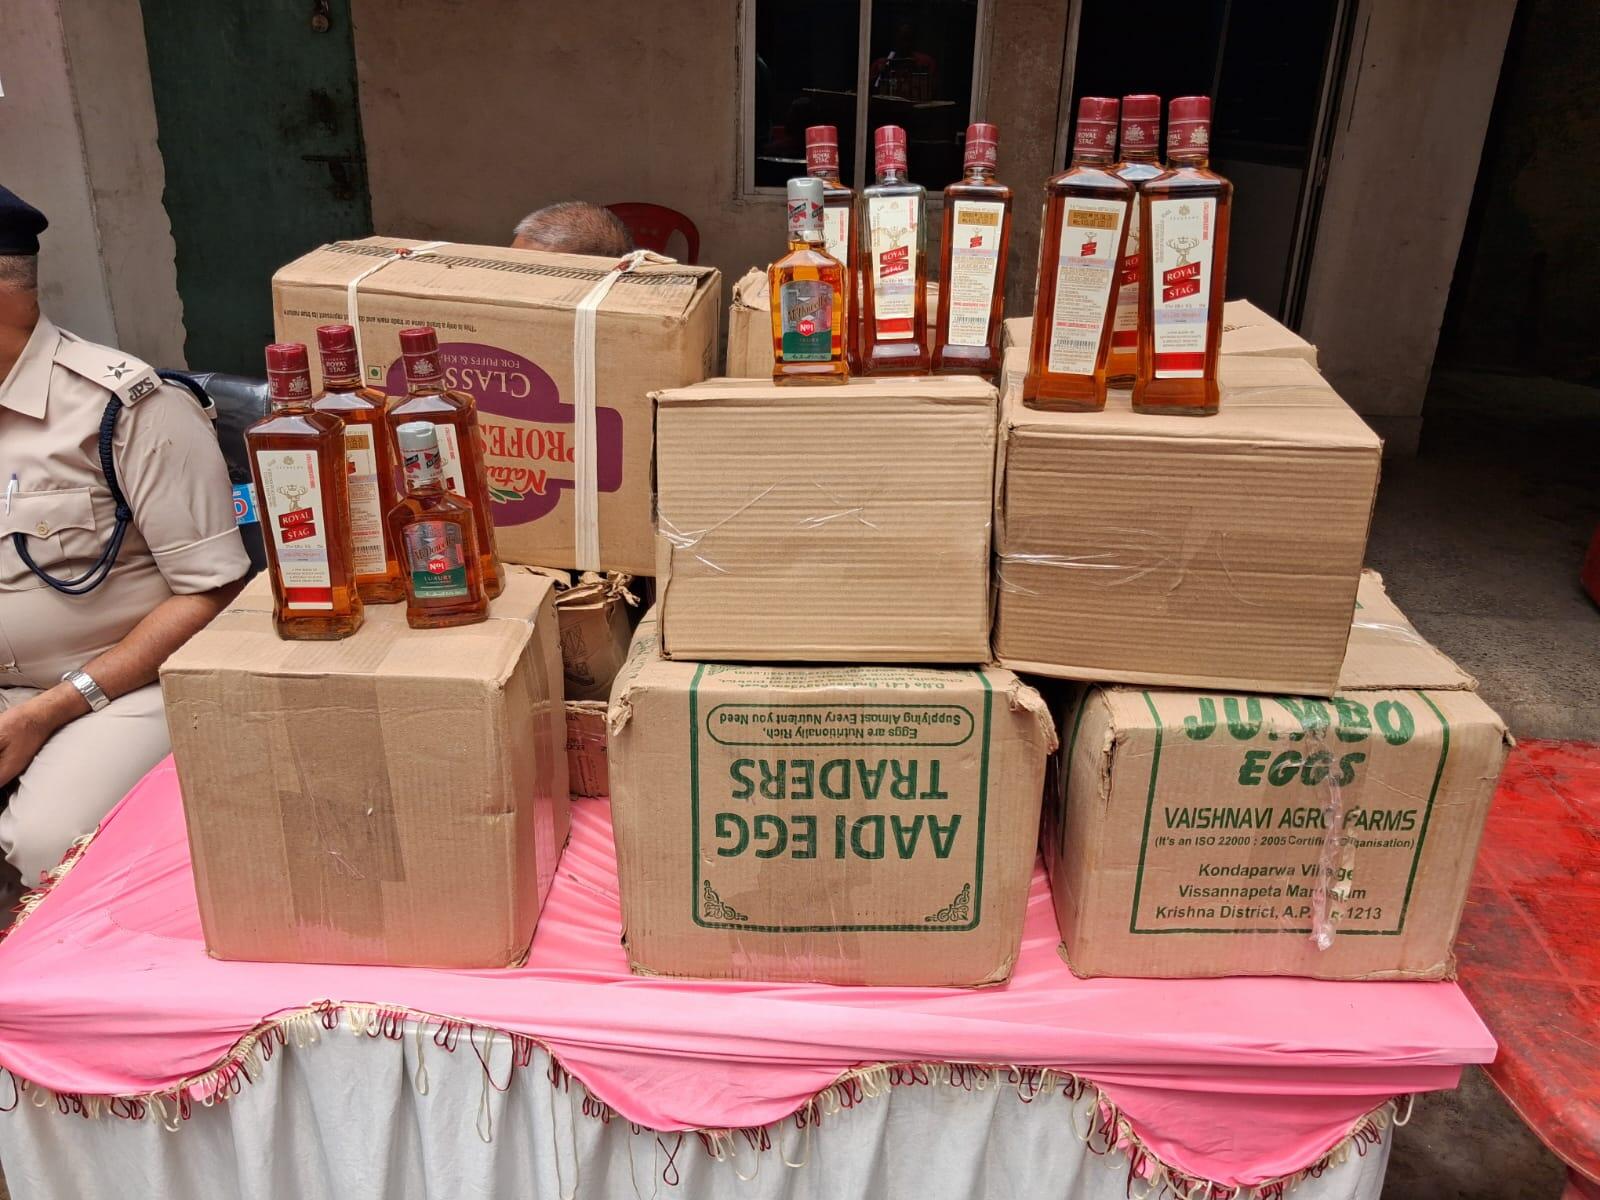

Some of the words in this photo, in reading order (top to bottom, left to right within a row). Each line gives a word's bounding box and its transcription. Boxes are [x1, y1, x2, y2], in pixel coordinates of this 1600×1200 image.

[882, 248, 906, 261] ROYAL
[1166, 266, 1198, 282] ROYAL
[1169, 284, 1194, 298] STAG
[376, 317, 390, 325] mark
[446, 321, 458, 330] only
[459, 354, 468, 362] &
[471, 357, 498, 367] PUFFS
[502, 360, 520, 369] FOR
[282, 510, 310, 525] ROYAL
[287, 527, 310, 541] STAG
[719, 712, 749, 724] Need
[752, 712, 774, 723] you
[776, 712, 822, 725] Nutrient
[825, 712, 857, 724] Every
[860, 713, 901, 725] Almost
[904, 713, 961, 726] Supplying
[763, 727, 792, 739] Rich,
[795, 726, 864, 740] Nutritionally
[867, 728, 886, 737] are
[888, 727, 918, 739] Eggs
[1238, 750, 1366, 787] EGGS
[730, 758, 949, 800] TRADERS
[1164, 807, 1273, 829] VAISHNAVI
[1342, 807, 1417, 831] FARMS
[715, 812, 817, 859] EGG
[835, 814, 962, 859] AADI
[1154, 836, 1176, 848] (It's
[1178, 838, 1191, 847] an
[1194, 836, 1215, 847] ISO
[1217, 836, 1251, 847] 22000
[1260, 836, 1287, 847] 2005
[1198, 864, 1296, 878] Kondaparwa
[1178, 885, 1281, 901] Vissannapeta
[1155, 906, 1215, 919] Krishna
[1219, 906, 1279, 920] District,
[1282, 905, 1312, 919] A.P.
